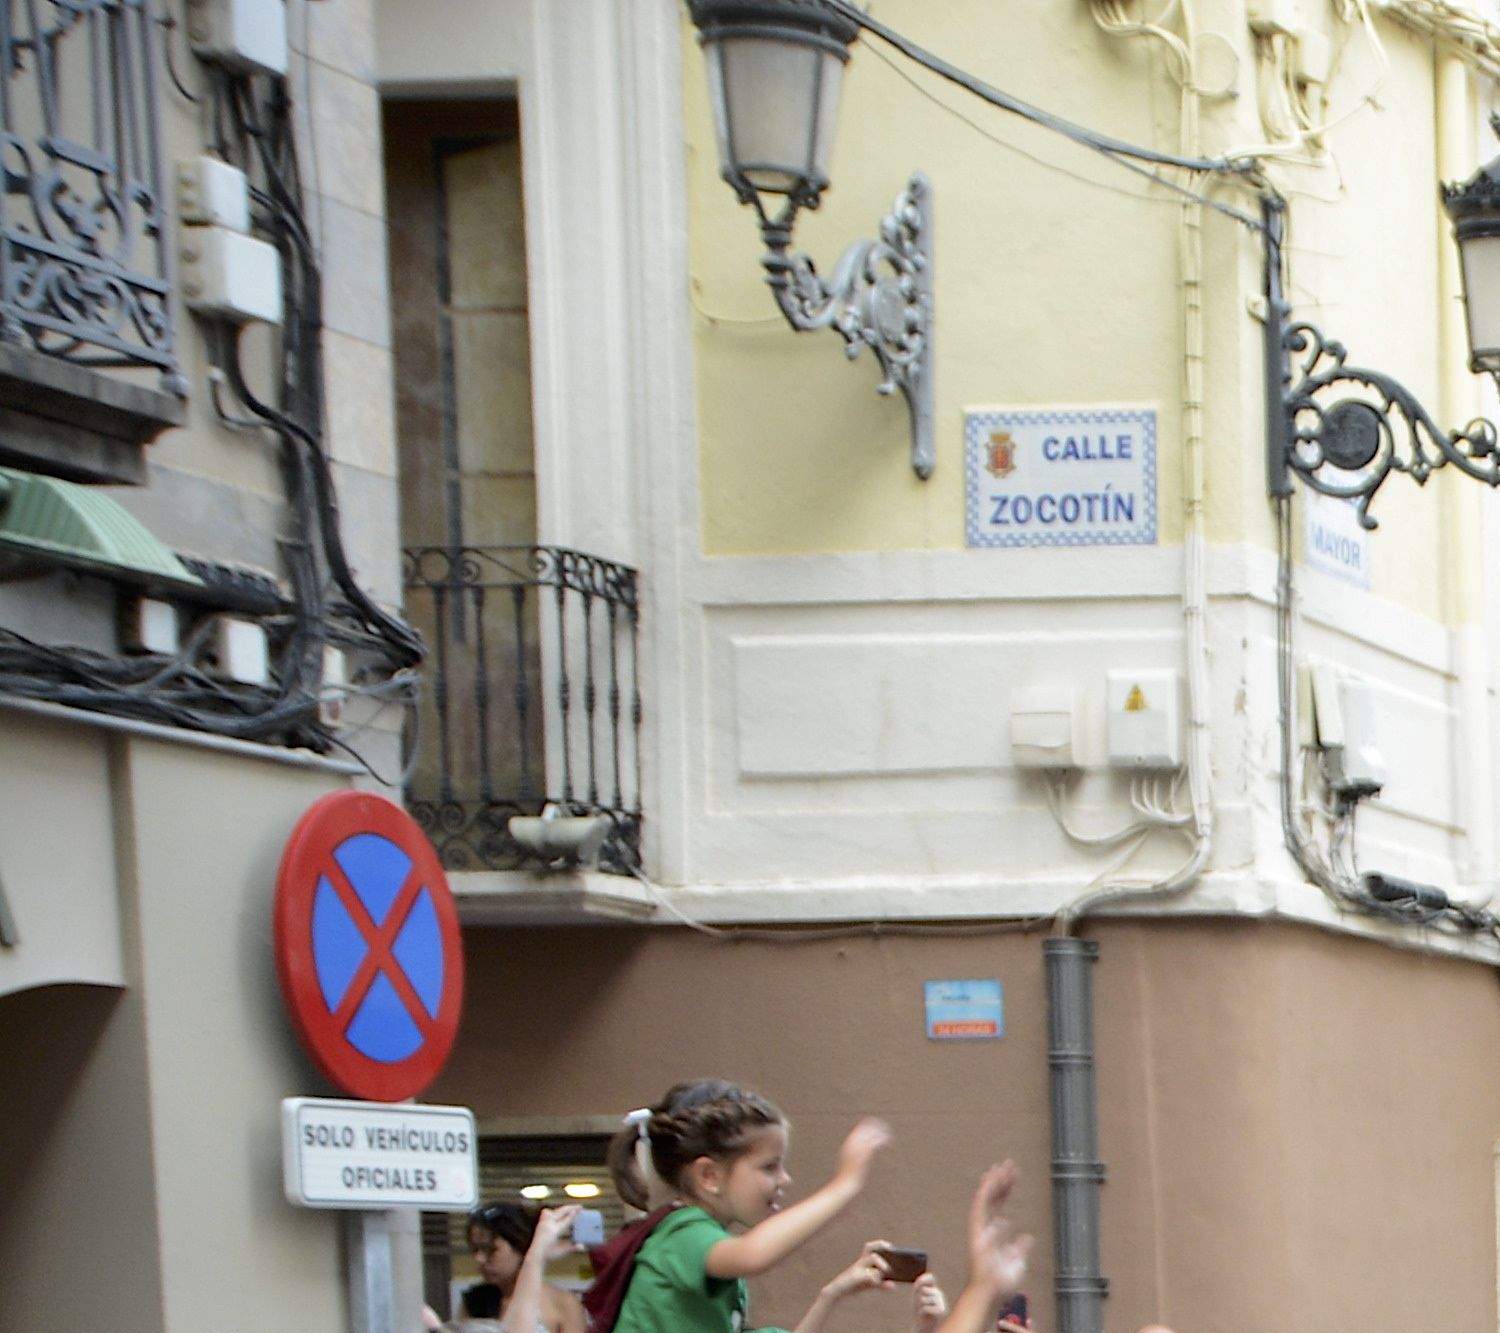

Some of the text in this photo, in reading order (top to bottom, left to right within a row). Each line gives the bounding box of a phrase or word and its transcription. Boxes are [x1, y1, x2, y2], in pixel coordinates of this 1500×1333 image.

[1042, 435, 1132, 461] CALLE
[989, 483, 1135, 525] ZOCOTÍN
[1312, 524, 1361, 569] MAYOR
[304, 1123, 469, 1153] SOLO VEHÍCULOS
[342, 1166, 436, 1191] OFICIALES
